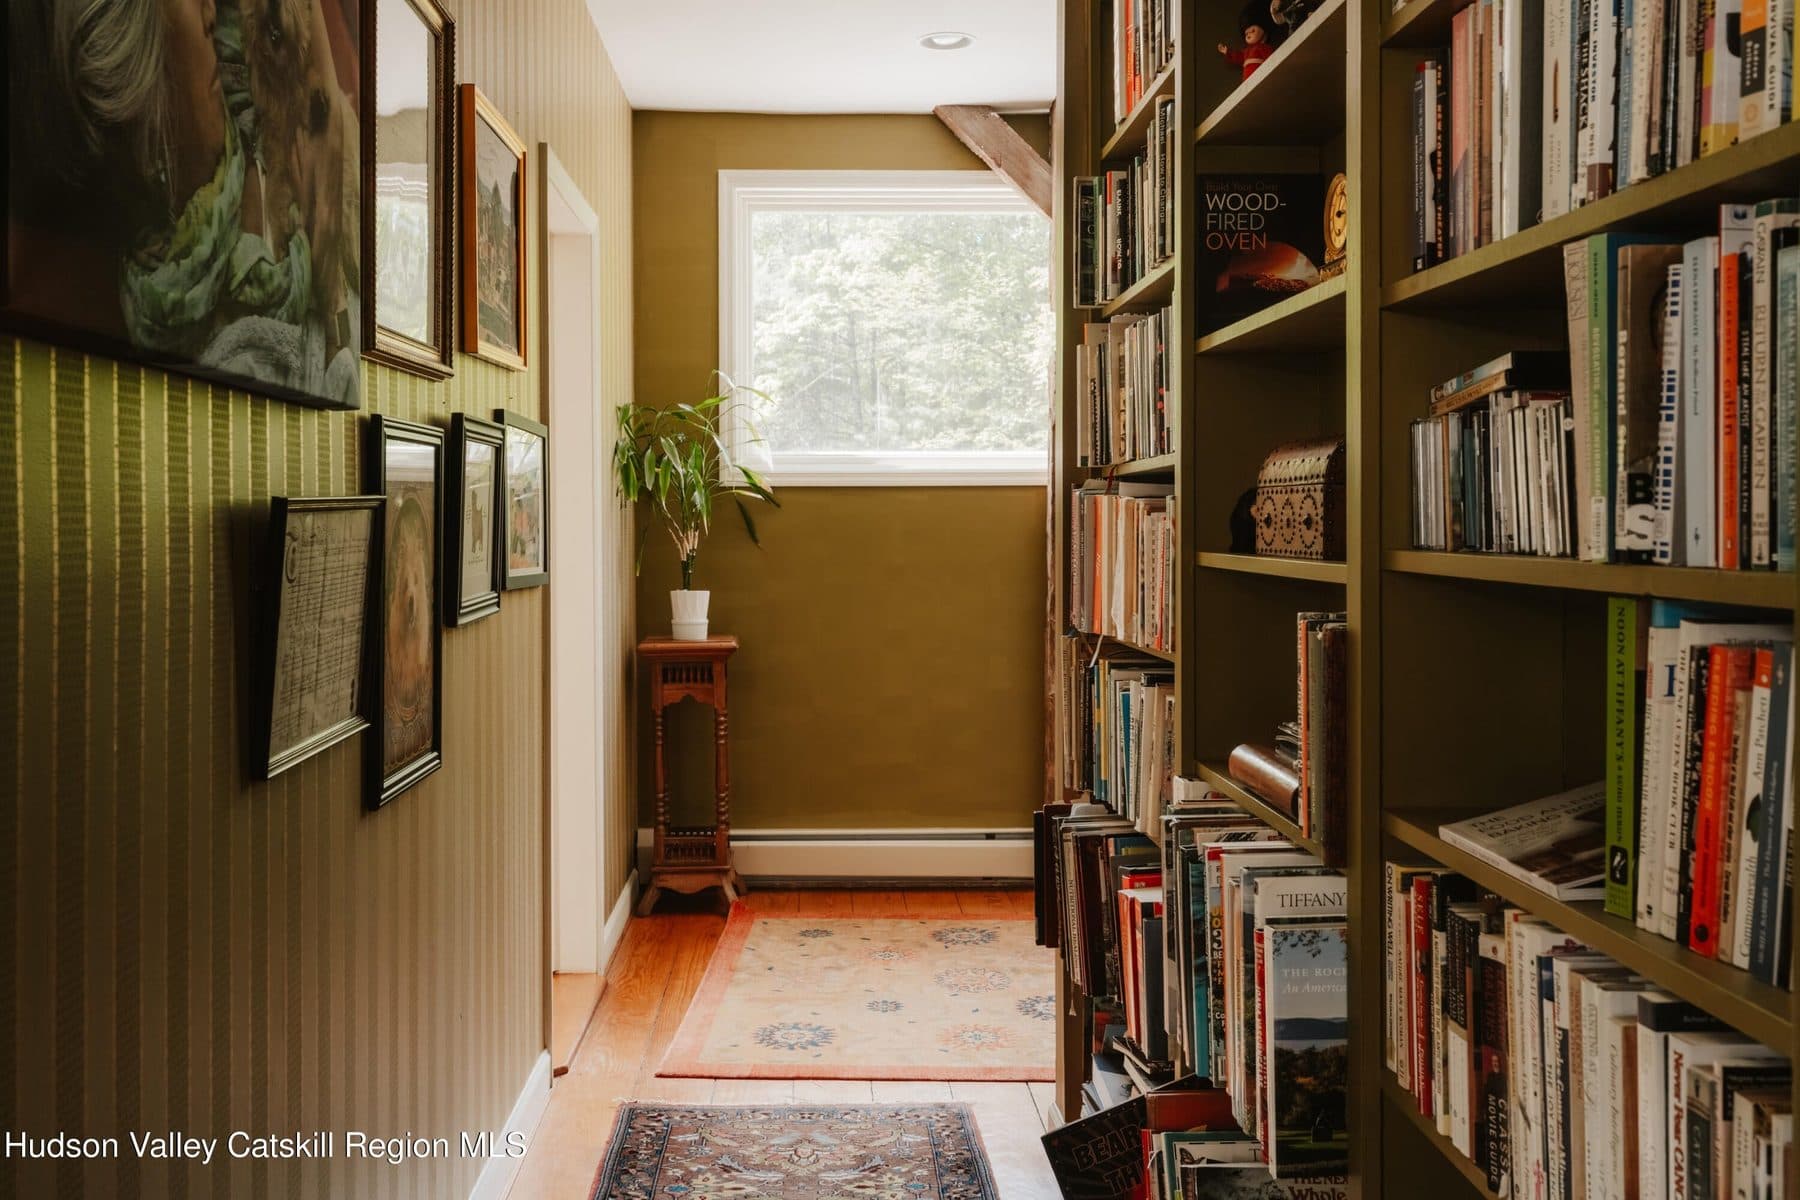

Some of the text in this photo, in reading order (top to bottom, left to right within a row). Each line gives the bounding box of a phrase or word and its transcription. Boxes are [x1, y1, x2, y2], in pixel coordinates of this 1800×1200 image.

[1579, 41, 1590, 130] THE SHACK
[1591, 40, 1599, 103] INVESTOR
[1768, 65, 1778, 111] GUIDE
[1159, 188, 1167, 223] Change
[1205, 193, 1287, 211] WOOD-
[1207, 213, 1265, 231] FIRED
[1206, 232, 1267, 250] OVEN
[1741, 330, 1750, 357] STEAL
[1753, 222, 1768, 491] GAWAIN RETURN GARDEN
[1617, 330, 1629, 416] Bernard
[1741, 360, 1750, 378] LIKE
[1740, 399, 1750, 427] ARTIST
[1615, 606, 1626, 656] NOON
[1615, 658, 1626, 677] AT
[1708, 653, 1722, 736] BLEEDING
[1615, 679, 1626, 763] TIFFANY'S
[1668, 648, 1687, 850] THE JANE AUSTEN BOOK CLUB
[1752, 752, 1763, 780] Ann
[1704, 740, 1717, 811] LONDON
[1386, 864, 1394, 885] ON
[1067, 879, 1077, 931] NUTRITIONAL
[1277, 891, 1348, 908] TIFFANY
[1386, 886, 1394, 930] WRITING
[1739, 855, 1758, 959] Commonwealth
[1386, 931, 1394, 957] WELL
[1280, 968, 1310, 978] THE
[1283, 983, 1347, 993] An America
[1546, 1064, 1554, 1088] THE
[1547, 1095, 1555, 1120] JOY
[1607, 1043, 1620, 1185] Culinary Intelligence
[1673, 1050, 1686, 1200] Never Fear CANC
[1486, 1094, 1499, 1183] MOVIE GUIDE
[1497, 1098, 1510, 1178] CLASS
[1549, 1124, 1556, 1145] OF
[1287, 1186, 1348, 1200] Whole
